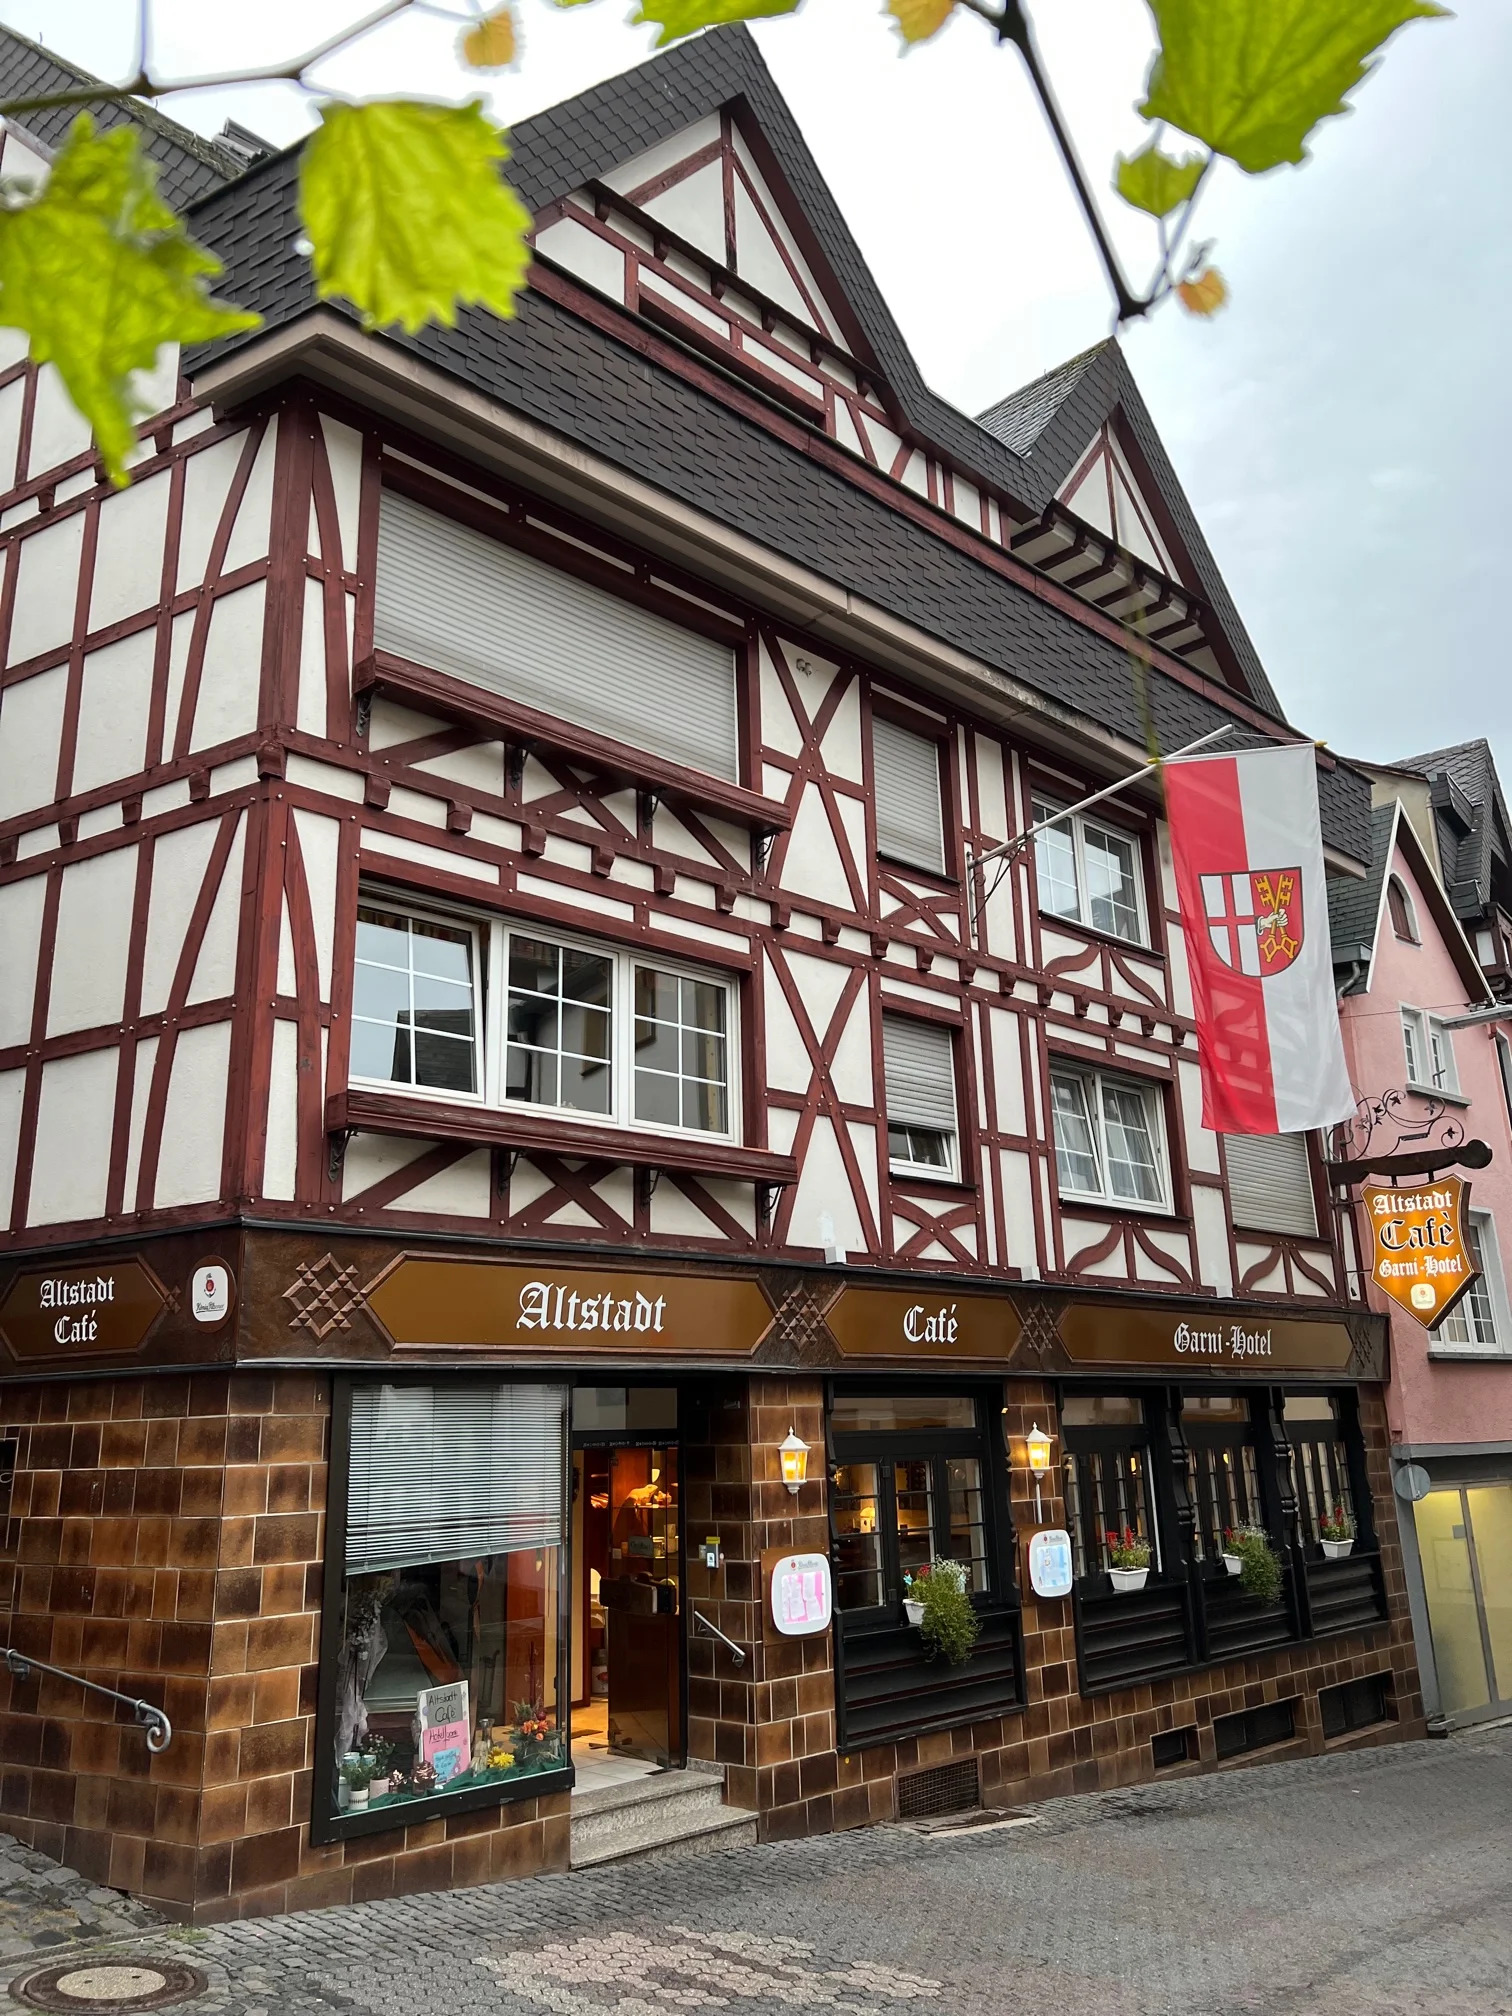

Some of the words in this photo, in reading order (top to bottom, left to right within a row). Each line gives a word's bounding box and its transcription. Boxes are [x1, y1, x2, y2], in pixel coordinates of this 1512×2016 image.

[1373, 1190, 1453, 1215] Altstadt
[40, 1276, 115, 1308] Altstadt
[516, 1281, 667, 1333] Altstadt
[54, 1309, 98, 1344] Café
[903, 1303, 959, 1343] Café
[429, 1691, 458, 1706] Altstadt
